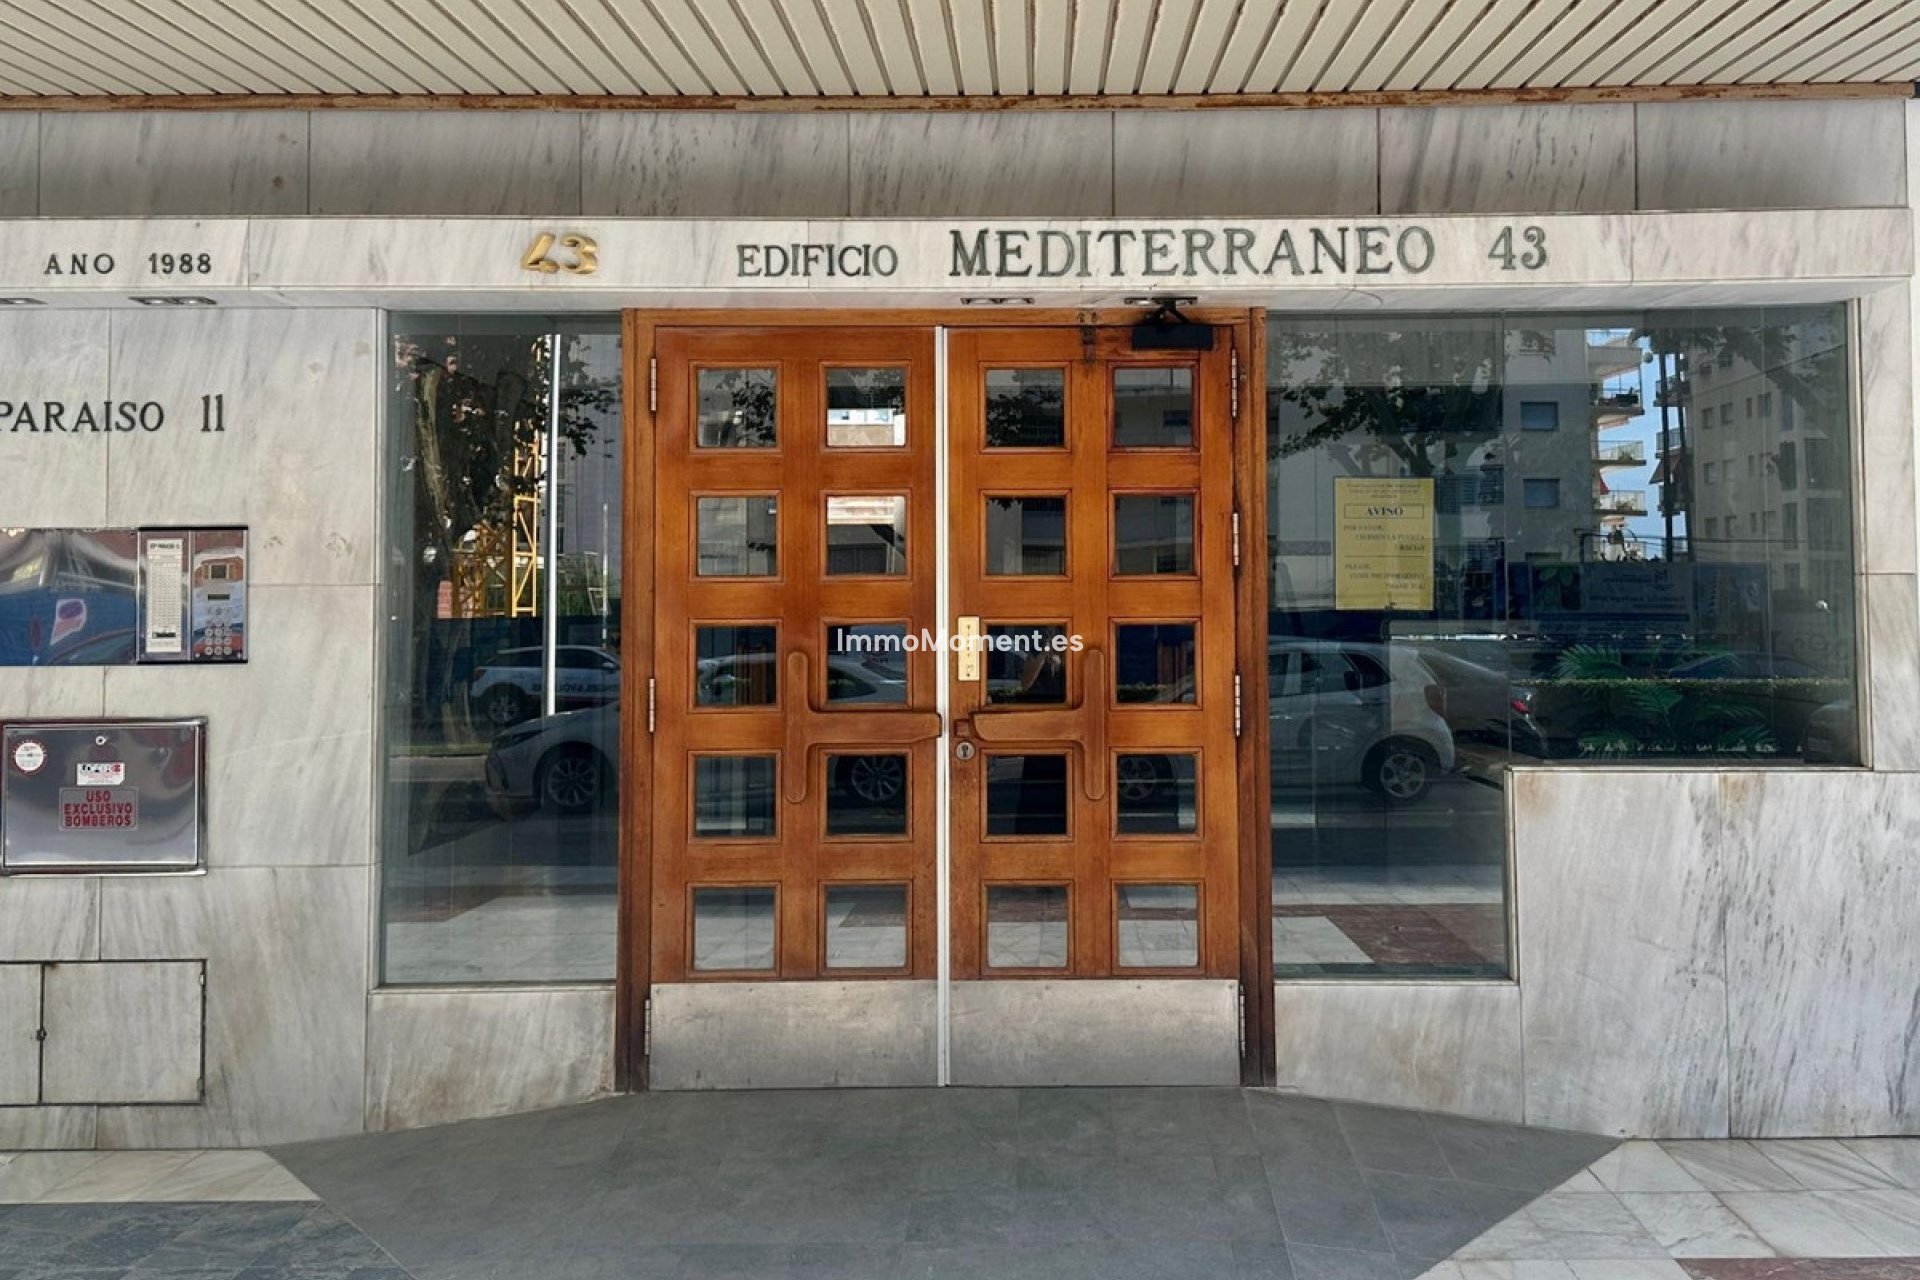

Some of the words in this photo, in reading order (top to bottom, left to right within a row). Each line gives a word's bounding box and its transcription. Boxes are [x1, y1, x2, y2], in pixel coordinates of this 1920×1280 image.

[521, 232, 598, 275] 43
[736, 244, 899, 278] EDIFICIO
[948, 227, 1436, 278] MEDITERRANEO
[1488, 225, 1548, 271] 43
[44, 252, 115, 275] ANO
[148, 252, 212, 275] 1988
[1367, 506, 1404, 517] AVISO
[86, 790, 112, 803] USO
[63, 803, 133, 815] EXCLUSIVO
[65, 815, 131, 827] BOMBEROS
